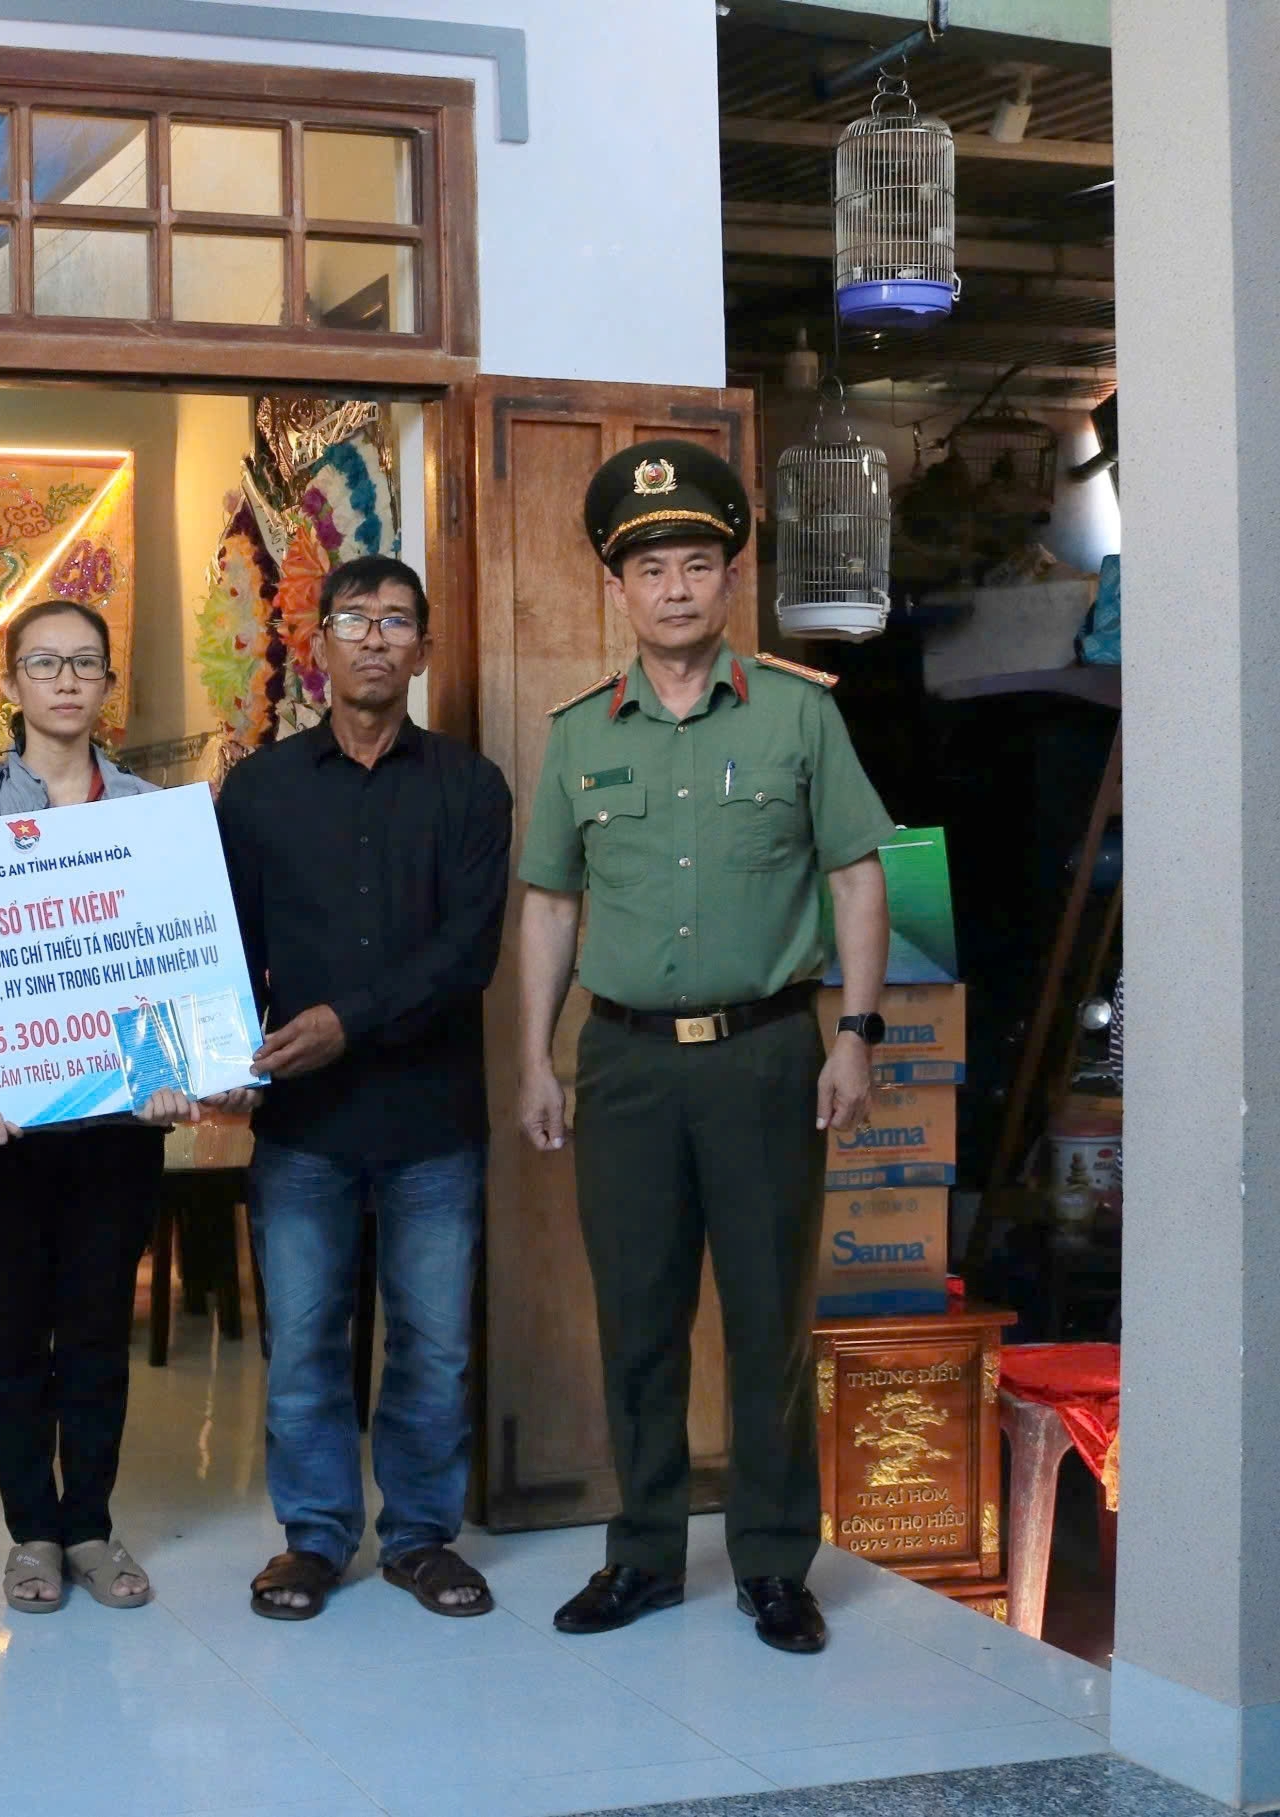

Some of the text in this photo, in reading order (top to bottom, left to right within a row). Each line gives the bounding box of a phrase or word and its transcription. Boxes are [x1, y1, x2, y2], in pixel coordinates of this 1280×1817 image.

[8, 863, 26, 877] AN
[59, 851, 103, 869] KHÁNH
[104, 844, 132, 862] HÒA
[24, 896, 65, 931] TIẾT
[21, 939, 43, 965] CHÍ
[44, 933, 82, 962] THIẾU
[84, 933, 103, 955] TÁ
[104, 921, 155, 953] NGUYỄN
[156, 918, 193, 943] XUÂN
[194, 910, 217, 936] HẢI
[4, 979, 22, 999] HY
[25, 974, 57, 996] SINH
[58, 966, 102, 992] TRONG
[103, 963, 126, 985] KHI
[127, 957, 156, 980] LÀM
[157, 948, 200, 976] NHIỆM
[200, 944, 219, 968] VỤ
[883, 1024, 937, 1043] nna
[24, 1058, 65, 1086] TRIỆU,
[66, 1059, 86, 1078] BA
[832, 1230, 926, 1265] Sanna
[846, 1369, 916, 1388] THÙNG
[908, 1485, 950, 1503] HÒM
[841, 1515, 885, 1535] CÔNG
[850, 1539, 890, 1552] 0979
[928, 1533, 959, 1546] 945
